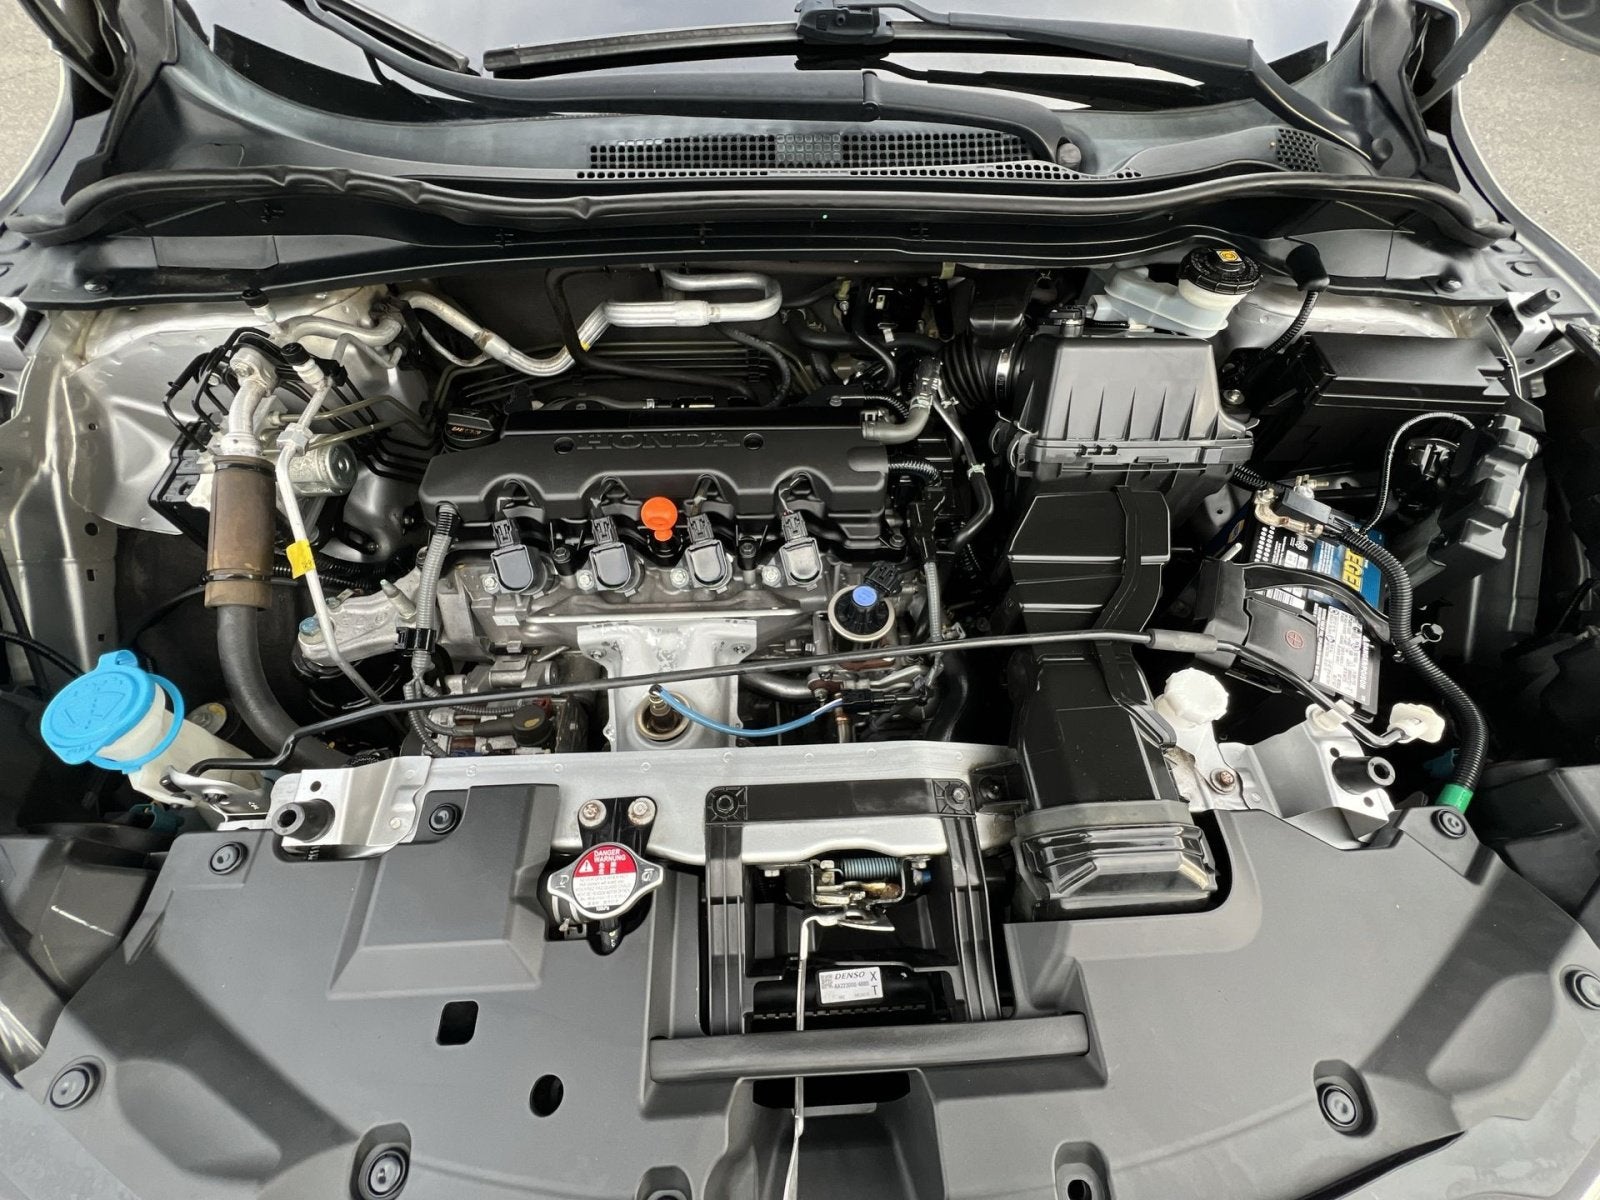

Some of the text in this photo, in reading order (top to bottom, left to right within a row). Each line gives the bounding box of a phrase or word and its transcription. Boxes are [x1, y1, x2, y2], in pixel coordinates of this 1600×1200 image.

[577, 432, 741, 450] HONDA
[593, 854, 626, 863] WARNUNG
[834, 971, 865, 980] DENSO
[870, 971, 877, 981] X
[871, 985, 878, 995] T
